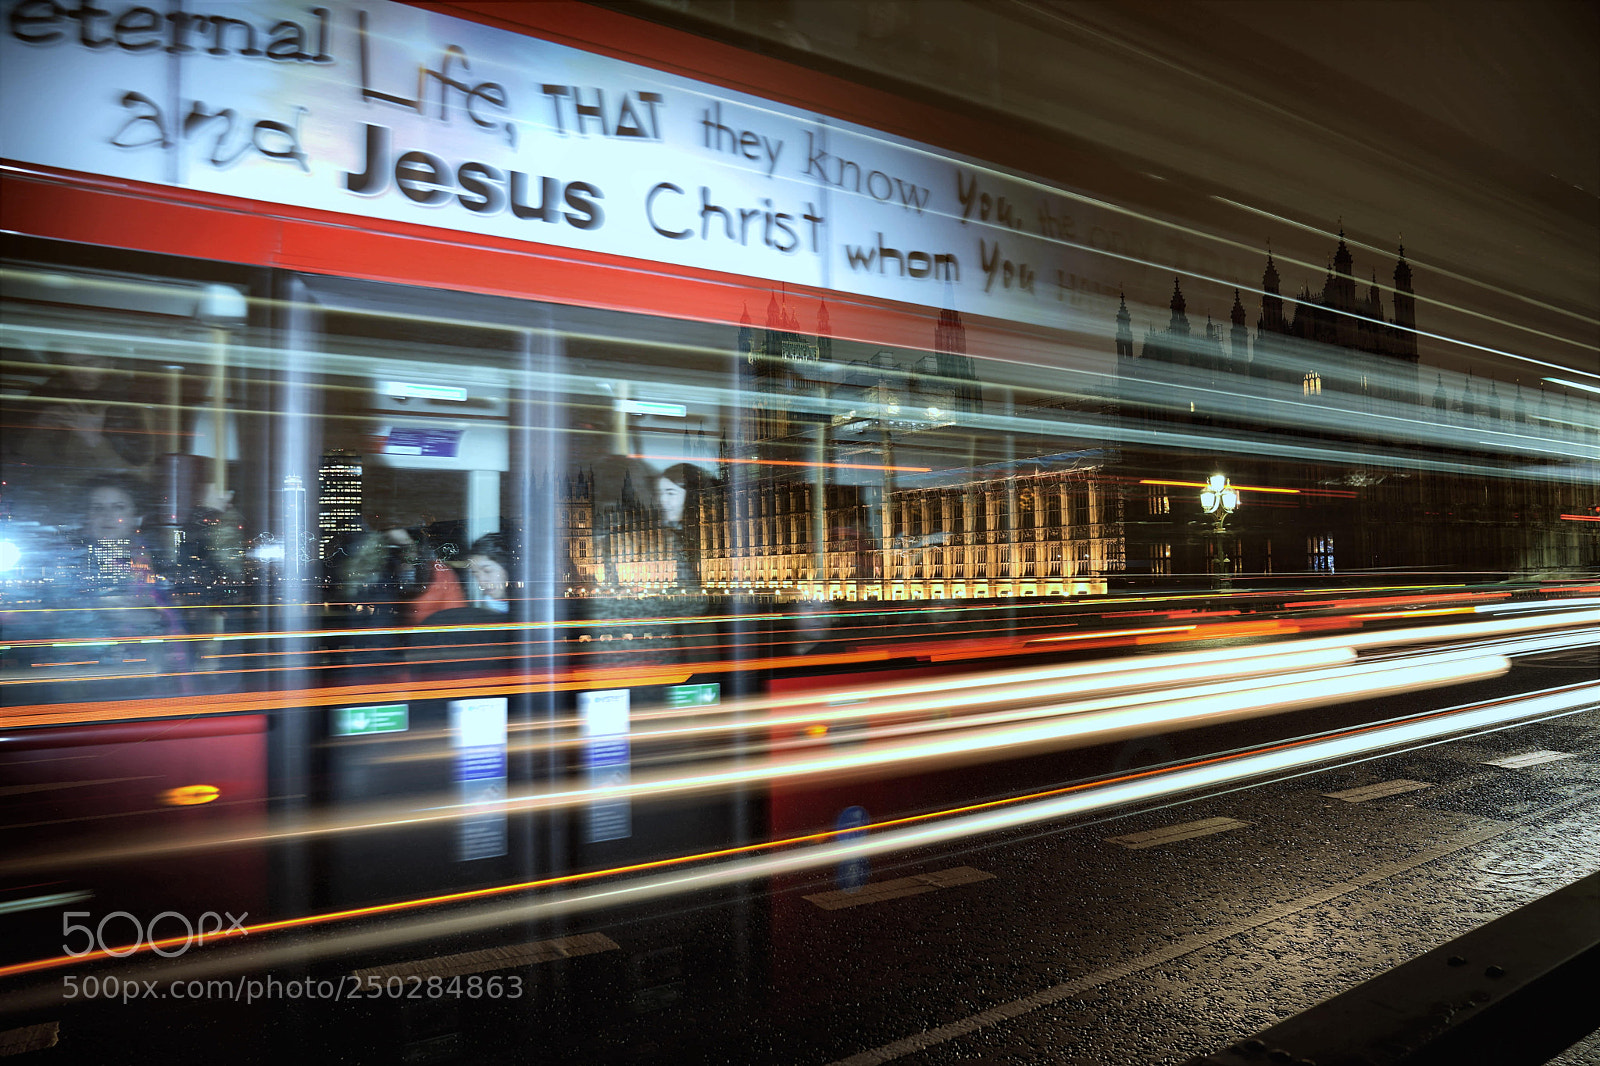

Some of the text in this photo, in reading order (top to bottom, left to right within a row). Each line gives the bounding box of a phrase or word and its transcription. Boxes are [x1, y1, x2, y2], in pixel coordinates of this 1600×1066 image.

[8, 0, 335, 64] eternal
[356, 8, 518, 152] Life,
[538, 82, 664, 140] THAT
[700, 100, 784, 178] they
[803, 128, 931, 216] know
[109, 90, 311, 173] and
[344, 122, 606, 231] Jesus
[645, 182, 825, 254] Christ
[842, 232, 960, 283] whom
[979, 236, 1036, 294] You
